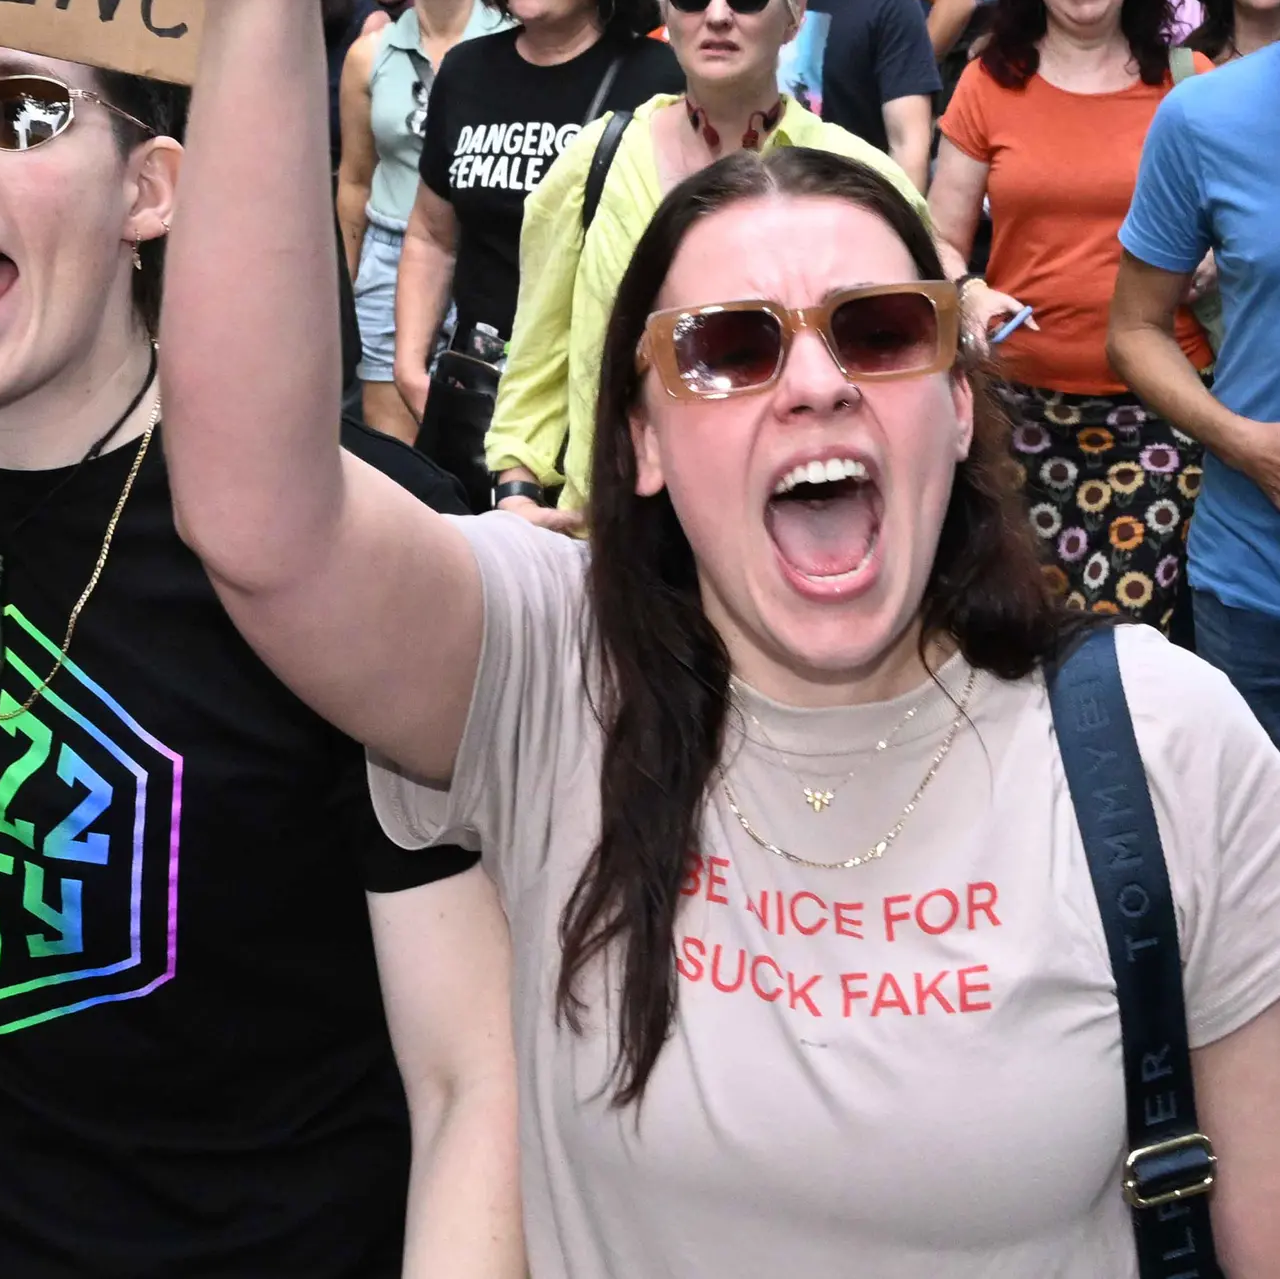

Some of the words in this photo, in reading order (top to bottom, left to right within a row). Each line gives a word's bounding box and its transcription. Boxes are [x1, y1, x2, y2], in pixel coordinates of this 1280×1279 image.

[454, 122, 584, 157] DANGERO
[1085, 746, 1159, 963] TOMMY
[746, 889, 863, 941] NICE
[882, 880, 1002, 943] FOR
[676, 936, 822, 1017] SUCK
[840, 965, 992, 1018] FAKE
